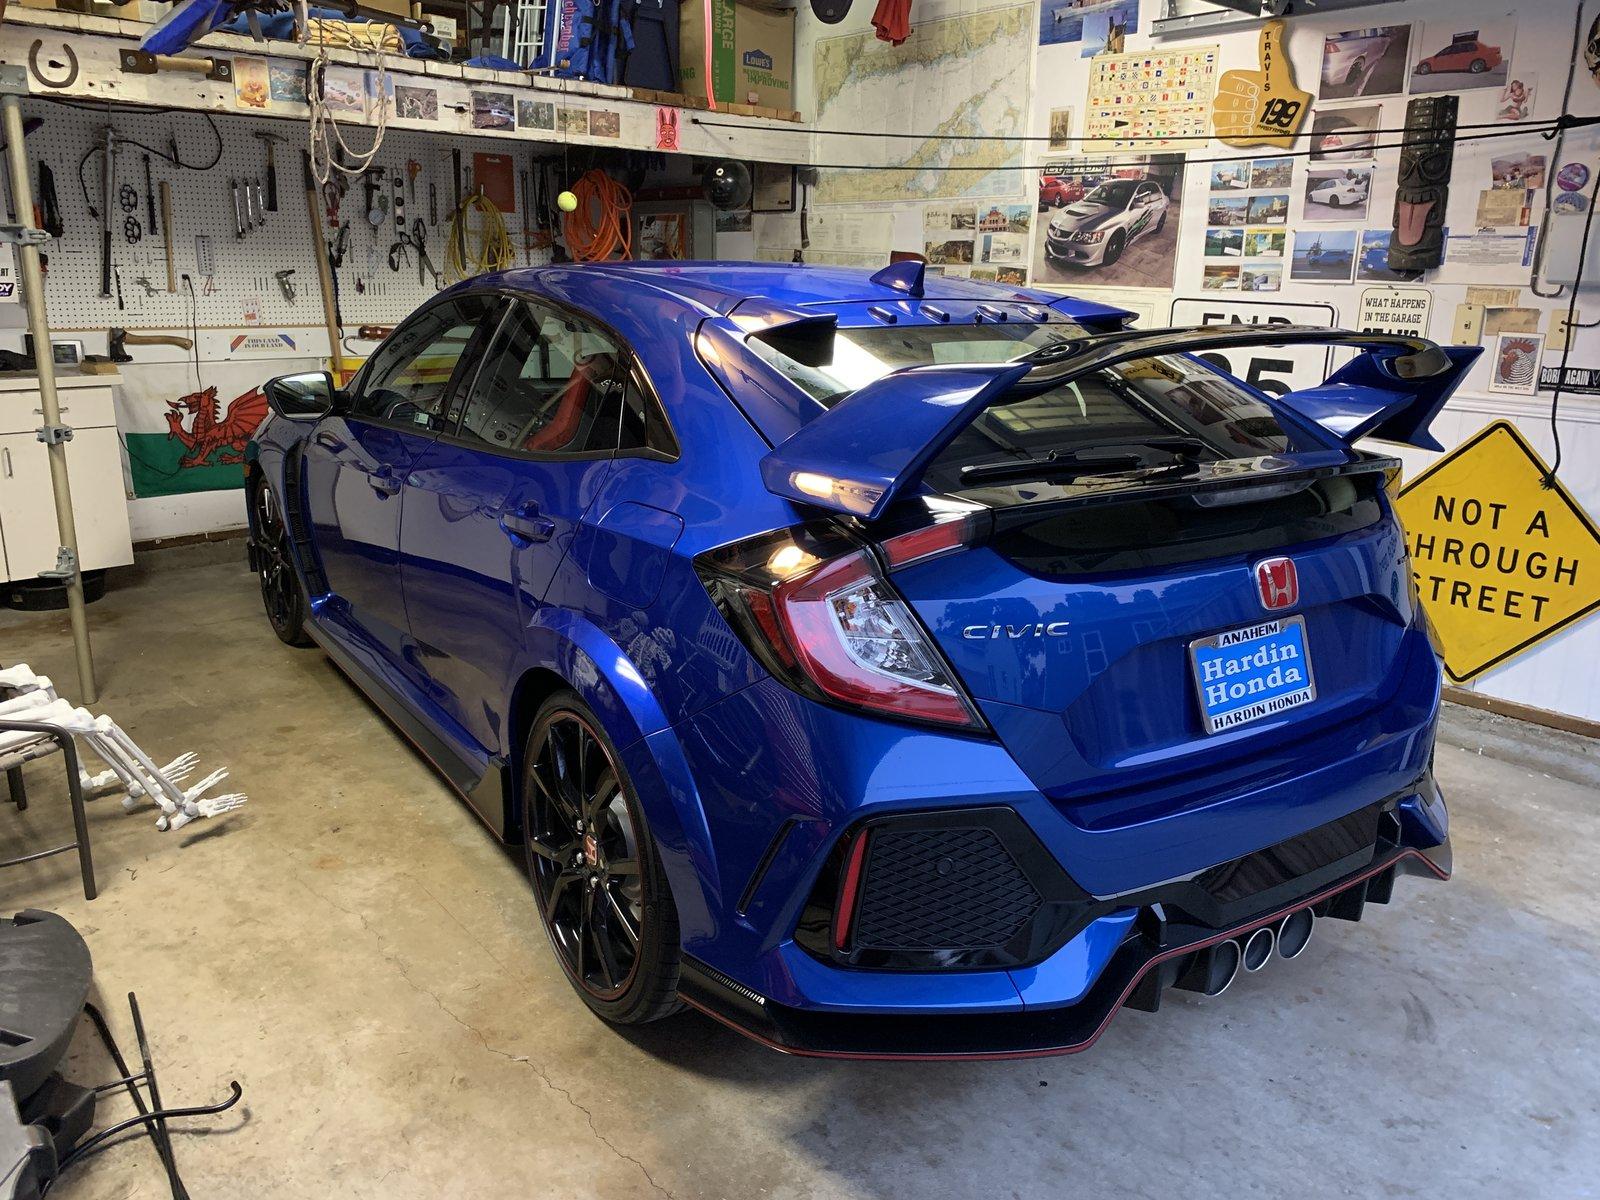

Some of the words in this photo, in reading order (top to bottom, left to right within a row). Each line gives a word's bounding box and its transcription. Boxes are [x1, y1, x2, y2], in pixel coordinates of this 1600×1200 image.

[1260, 98, 1301, 127] 199
[1364, 312, 1373, 321] IN
[1375, 312, 1390, 322] THE
[1391, 313, 1422, 324] GARAGE
[1365, 298, 1390, 308] WHAT
[1390, 299, 1427, 309] HAPPENS
[1564, 369, 1590, 386] AGAIN
[1433, 495, 1507, 530] NOT
[1525, 510, 1549, 538] A
[1407, 531, 1579, 586] HROUGH
[963, 622, 1070, 639] CIVIC
[1222, 622, 1278, 646] ANAHEIM
[1202, 643, 1298, 682] Hardin
[1206, 666, 1302, 707] Honda
[1213, 704, 1266, 729] HARDIN
[1269, 691, 1310, 712] HONDA
